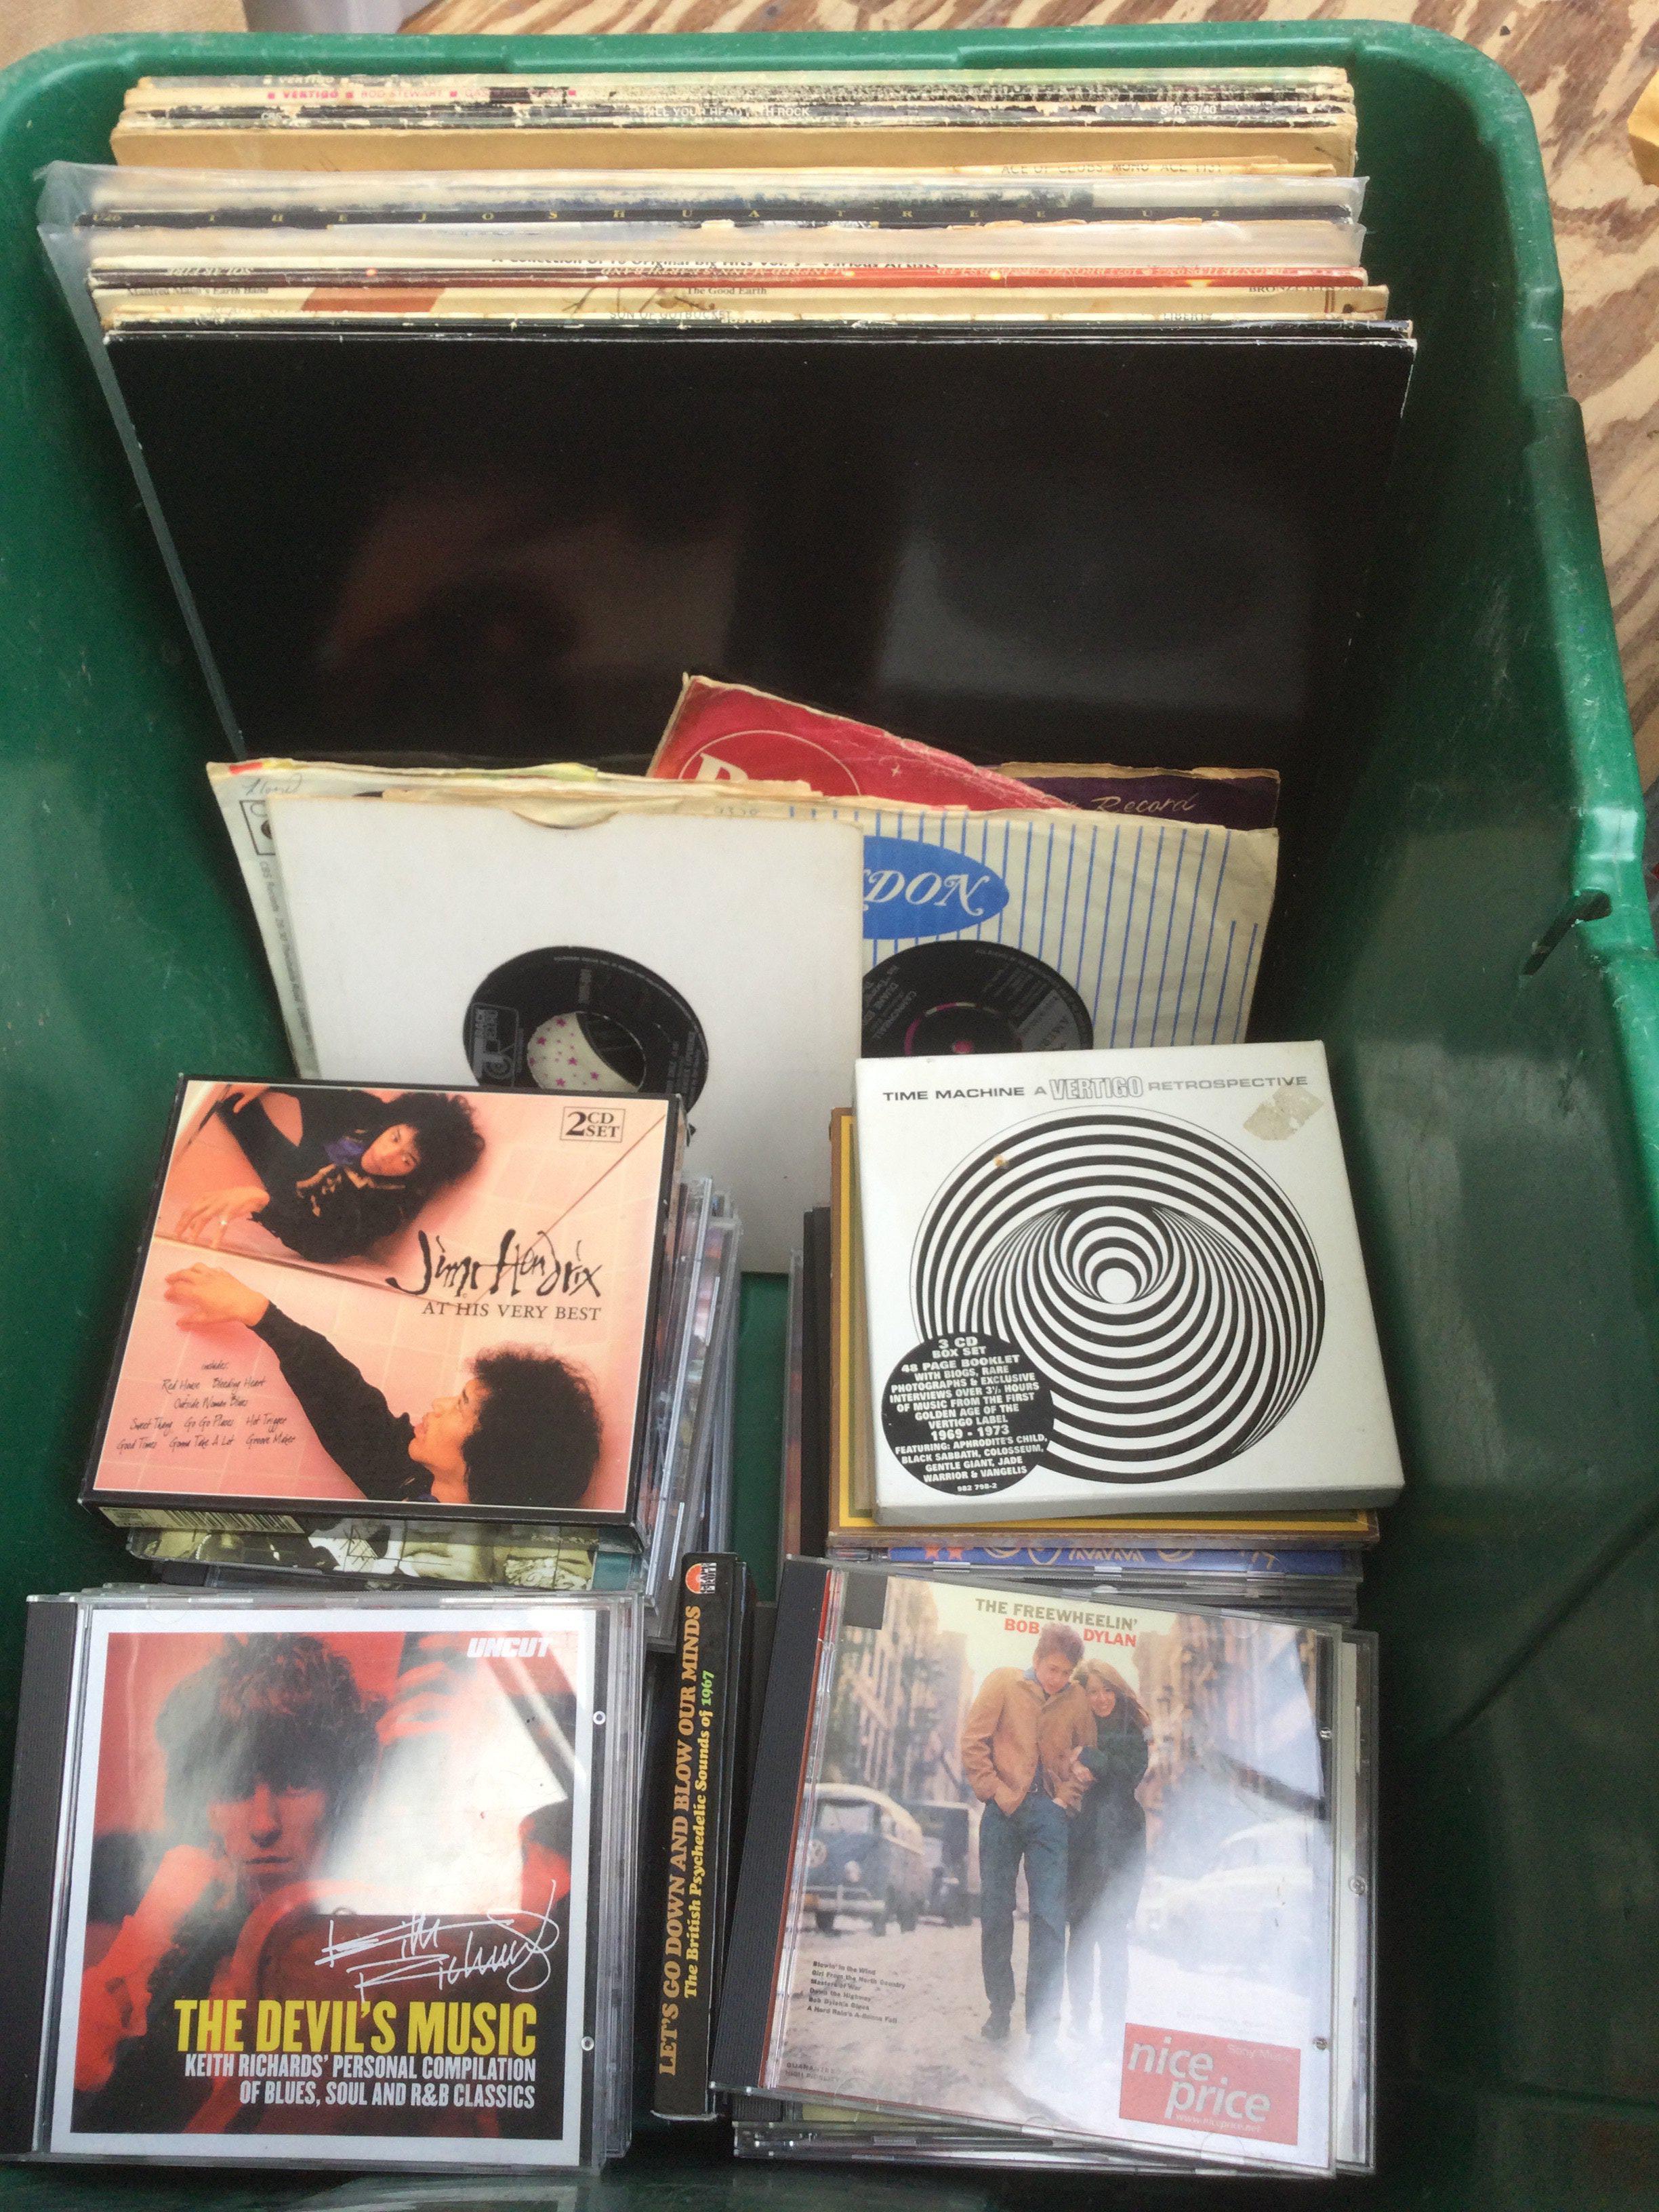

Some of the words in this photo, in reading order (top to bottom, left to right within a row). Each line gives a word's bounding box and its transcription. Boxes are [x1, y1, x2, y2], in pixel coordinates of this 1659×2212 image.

[1091, 792, 1200, 814] Record
[863, 868, 990, 916] DON
[883, 1090, 928, 1101] TIME
[935, 1086, 1025, 1100] MACHINE
[1033, 1086, 1048, 1096] A
[1049, 1076, 1144, 1101] VERTIGO
[1148, 1076, 1309, 1091] RETROSPECTIVE
[565, 1111, 587, 1136] 2
[587, 1111, 615, 1124] CD
[586, 1125, 620, 1137] SET
[489, 1228, 603, 1298] Hendrix
[422, 1301, 450, 1315] AT
[455, 1303, 489, 1317] HIS
[497, 1304, 549, 1319] VERY
[555, 1305, 602, 1322] BEST
[932, 1349, 959, 1359] BOX
[962, 1346, 987, 1356] SET
[938, 1338, 949, 1349] 3
[954, 1336, 979, 1348] CD
[901, 1364, 919, 1373] 48
[922, 1360, 958, 1372] PAGE
[960, 1355, 1021, 1368] BOOKLET
[914, 1371, 941, 1382] WITH
[943, 1368, 979, 1379] BIOGS,
[981, 1365, 1010, 1376] RARE
[161, 1378, 178, 1394] Red
[180, 1378, 201, 1391] House
[243, 1376, 267, 1389] Heart
[889, 1389, 953, 1404] INTERVIEWS
[955, 1387, 983, 1397] OVER
[1004, 1382, 1040, 1393] HOURS
[891, 1378, 968, 1393] PHOTOGRAPHS
[970, 1378, 979, 1386] &
[980, 1372, 1036, 1385] EXCLUSIVE
[896, 1404, 911, 1412] OF
[913, 1400, 948, 1412] MUSIC
[950, 1397, 981, 1408] FROM
[983, 1395, 1003, 1405] THE
[1005, 1392, 1035, 1404] FIRST
[914, 1409, 957, 1421] GOLDEN
[960, 1407, 981, 1417] AGE
[983, 1406, 998, 1415] OF
[999, 1403, 1020, 1413] THE
[928, 1417, 973, 1430] VERTIGO
[975, 1414, 1008, 1425] LABEL
[930, 1428, 964, 1441] 1969
[977, 1424, 1010, 1437] 1973
[895, 1442, 951, 1455] FEATURING:
[953, 1436, 1015, 1450] APHRODITE'S
[1015, 1433, 1048, 1443] CHILD,
[901, 1453, 933, 1465] BLACK
[935, 1449, 982, 1462] SABBATH,
[983, 1444, 1045, 1457] COLOSSEUM,
[922, 1470, 969, 1483] WARRIOR
[970, 1469, 979, 1478] &
[980, 1465, 1028, 1478] VANGELIS
[924, 1460, 962, 1473] GENTLE
[963, 1458, 996, 1469] GIANT,
[997, 1456, 1023, 1466] JADE
[975, 1597, 1009, 1615] THE
[1012, 1603, 1139, 1631] FREEWHEELIN'
[681, 1605, 702, 1683] MINDS
[1004, 1618, 1040, 1635] BOB
[1083, 1628, 1137, 1647] DYLAN
[466, 1637, 554, 1658] UNCUT
[701, 1669, 716, 1707] 1967
[678, 1685, 697, 1736] OUR
[699, 1709, 714, 1727] of
[694, 1729, 710, 1791] Sounds
[674, 1740, 693, 1812] BLOW
[670, 1816, 689, 1872] AND
[689, 1794, 708, 1897] Psychedelic
[665, 1874, 685, 1957] DOWN
[686, 1899, 702, 1961] British
[663, 1961, 682, 1999] GO
[684, 1963, 699, 1999] The
[173, 1999, 247, 2052] THE
[255, 1999, 397, 2055] DEVIL'S
[407, 2001, 538, 2057] MUSIC
[659, 2002, 680, 2076] LET'S
[184, 2053, 235, 2077] KEITH
[238, 2053, 329, 2078] RICHARDS'
[331, 2054, 418, 2080] PERSONAL
[421, 2055, 537, 2083] COMPILATION
[1127, 2035, 1214, 2081] nice
[239, 2079, 262, 2105] OF
[264, 2080, 322, 2108] BLUES,
[325, 2081, 369, 2106] SOUL
[371, 2082, 407, 2107] AND
[410, 2082, 450, 2108] R&B
[453, 2083, 536, 2110] CLASSICS
[1164, 2076, 1271, 2124] price
